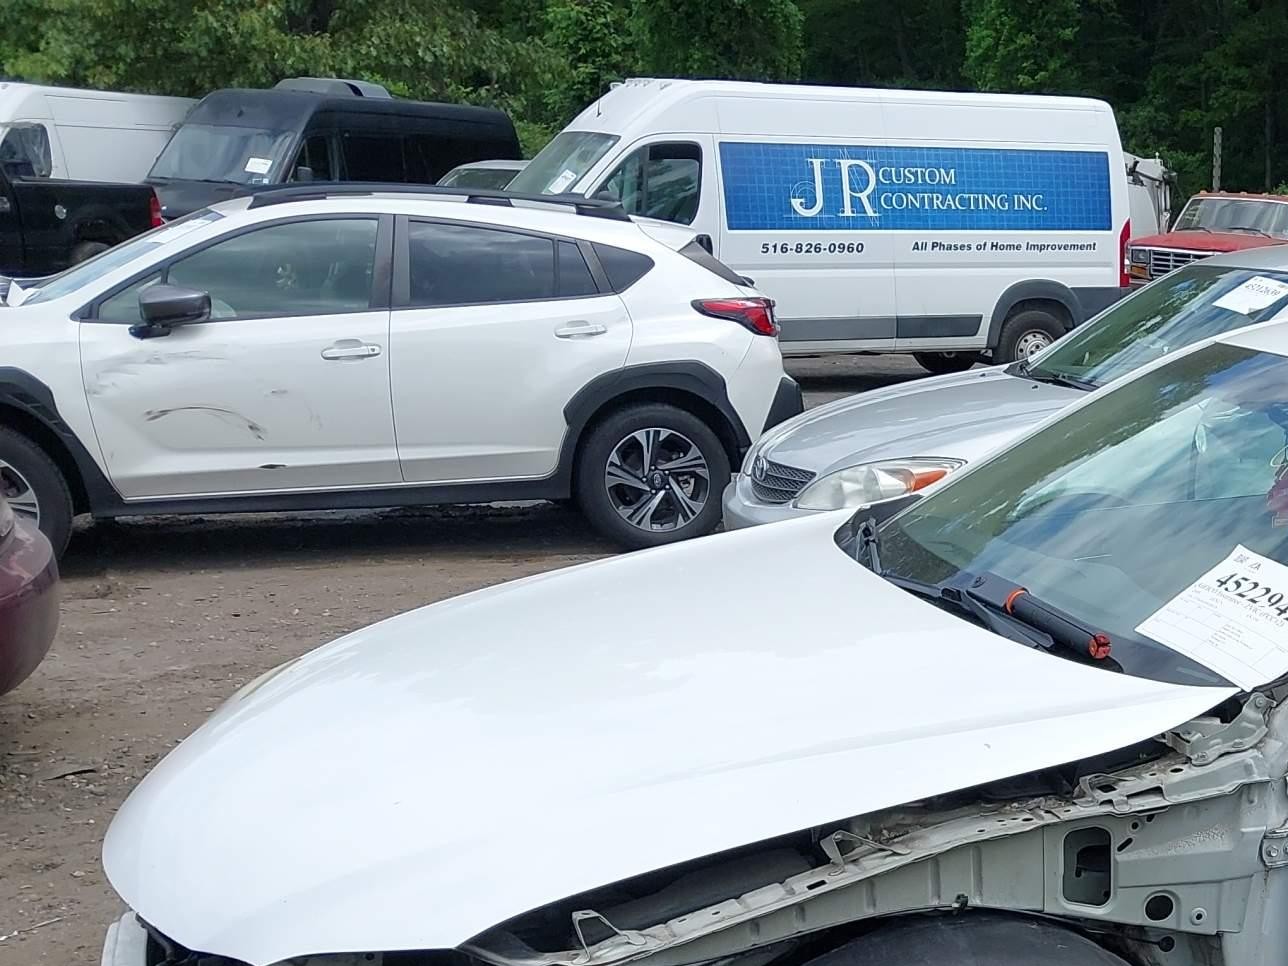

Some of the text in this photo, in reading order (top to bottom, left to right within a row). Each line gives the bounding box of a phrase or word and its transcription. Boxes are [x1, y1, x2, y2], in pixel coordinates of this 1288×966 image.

[879, 167, 956, 185] CUSTOM
[880, 192, 1049, 211] CONTRACTING INC.
[760, 242, 865, 254] 516-826-0960
[912, 241, 1097, 253] All Phases of Home Improvement
